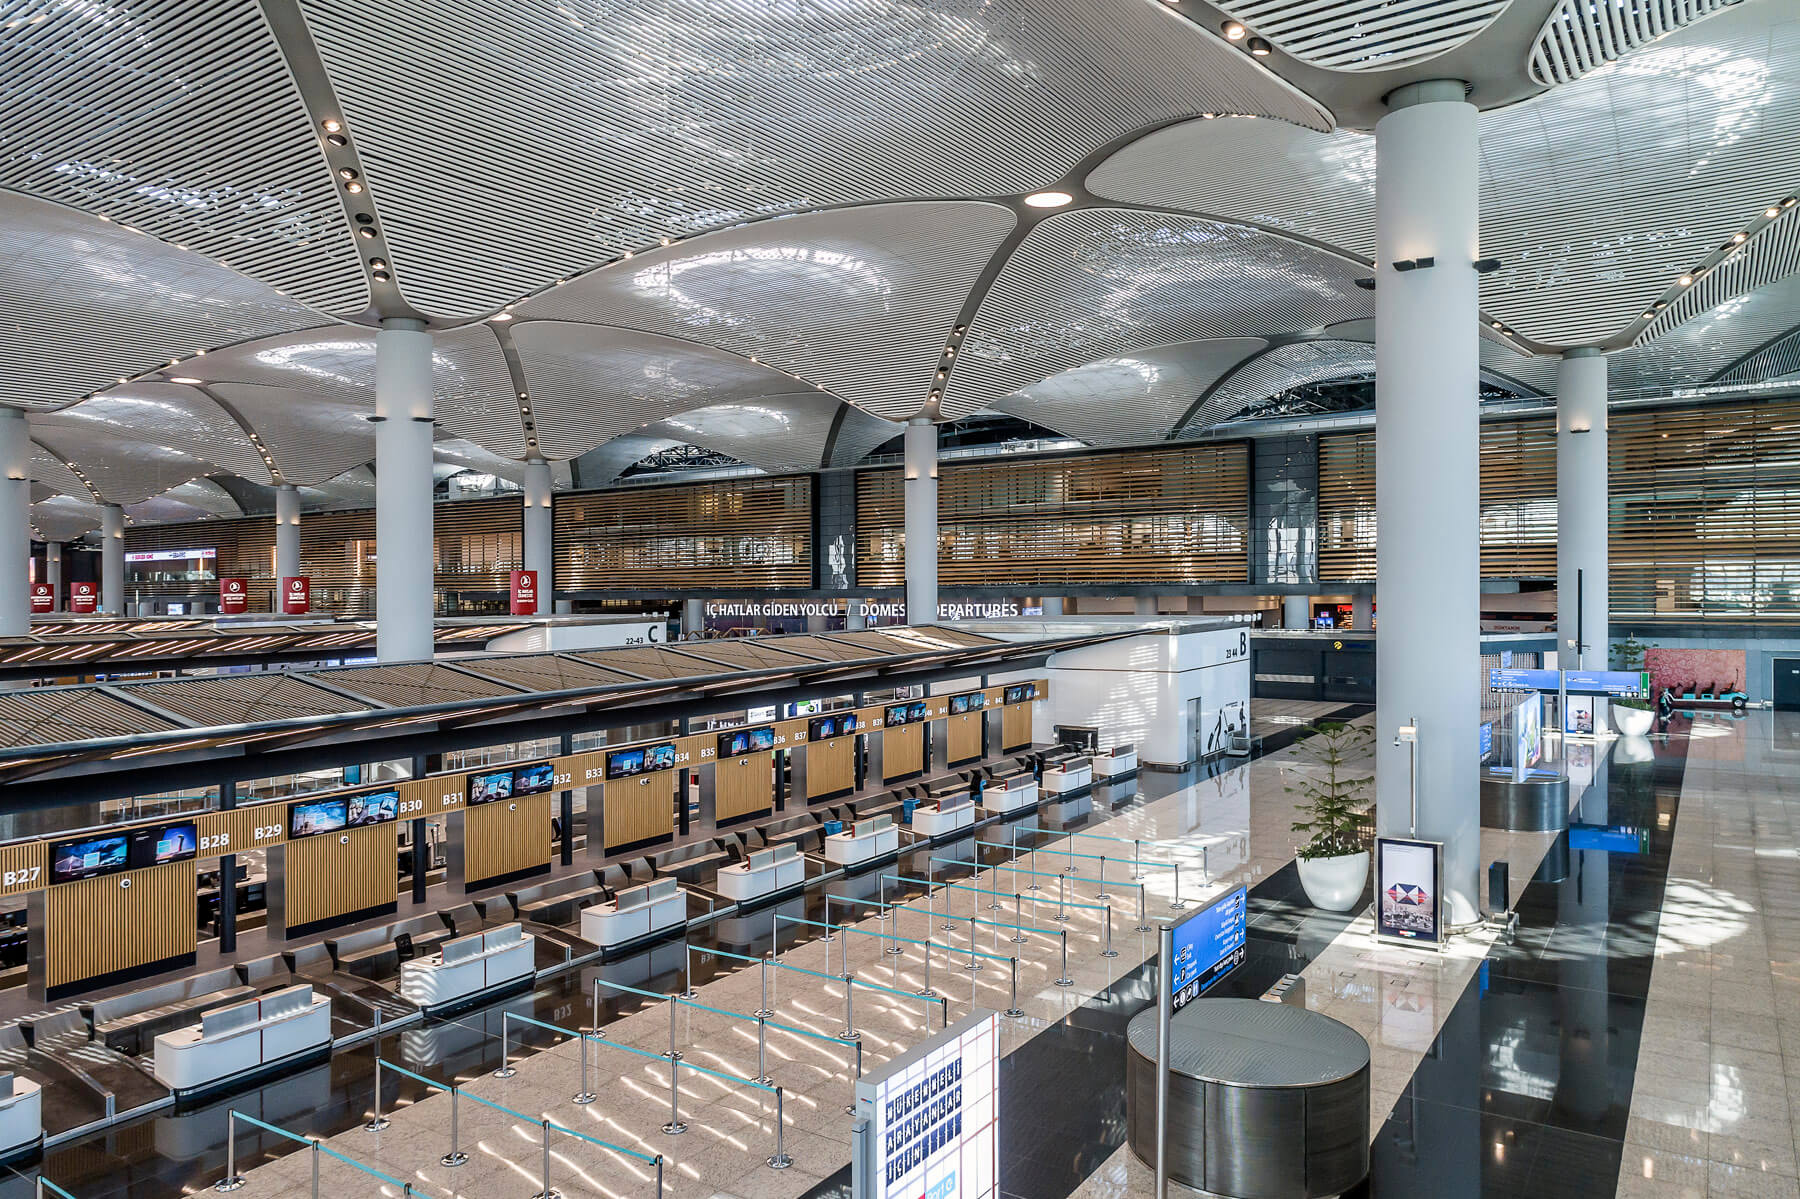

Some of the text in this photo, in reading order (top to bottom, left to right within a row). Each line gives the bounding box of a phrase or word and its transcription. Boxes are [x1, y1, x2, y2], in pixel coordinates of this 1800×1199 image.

[706, 602, 717, 619] İÇ
[719, 604, 760, 616] HATLAR
[763, 601, 797, 617] GİDEN
[799, 604, 838, 616] YOLCU
[860, 604, 906, 617] DOMES
[648, 625, 658, 643] C
[1240, 632, 1247, 656] B
[773, 735, 786, 745] B36
[794, 731, 807, 741] B37
[675, 752, 689, 763] B34
[701, 747, 715, 758] B35
[553, 773, 572, 785] B32
[585, 767, 603, 780] B33
[400, 799, 423, 814] B30
[442, 791, 464, 806] B31
[254, 824, 283, 841] B29
[200, 833, 230, 850] B28
[3, 866, 41, 887] B27
[887, 1058, 961, 1122] MÜKEMMELİ
[887, 1089, 961, 1150] ARAYANLAR
[888, 1145, 920, 1181] İÇİN
